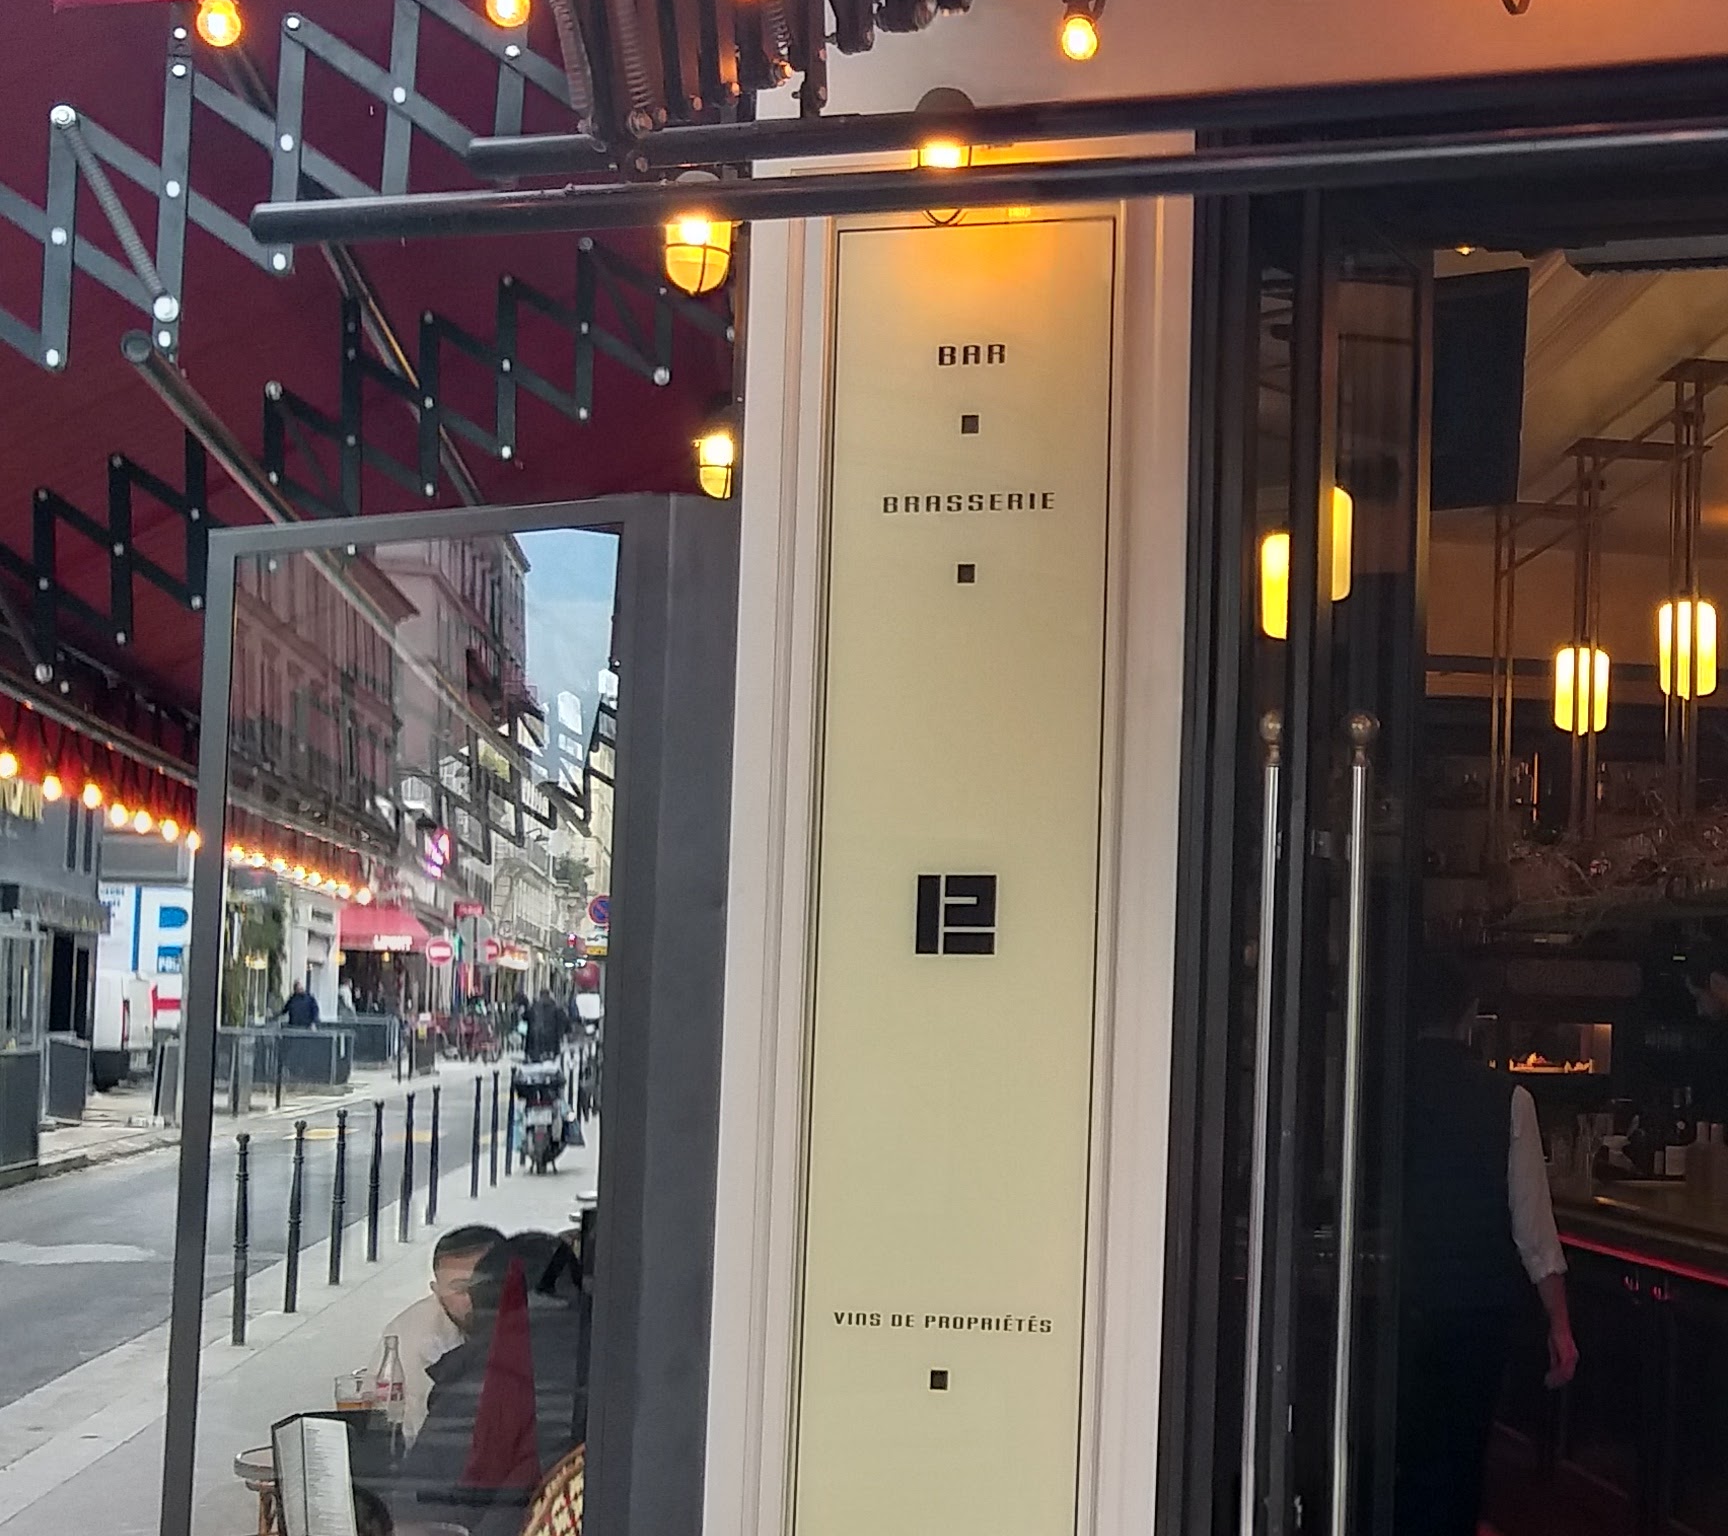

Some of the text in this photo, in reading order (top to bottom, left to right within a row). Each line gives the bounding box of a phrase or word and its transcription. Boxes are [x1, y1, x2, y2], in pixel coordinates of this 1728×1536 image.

[937, 344, 1006, 366] BAR
[882, 492, 1056, 514] BRASSERIE
[834, 1312, 1053, 1333] VINS DE PROPRIÉTÉS
